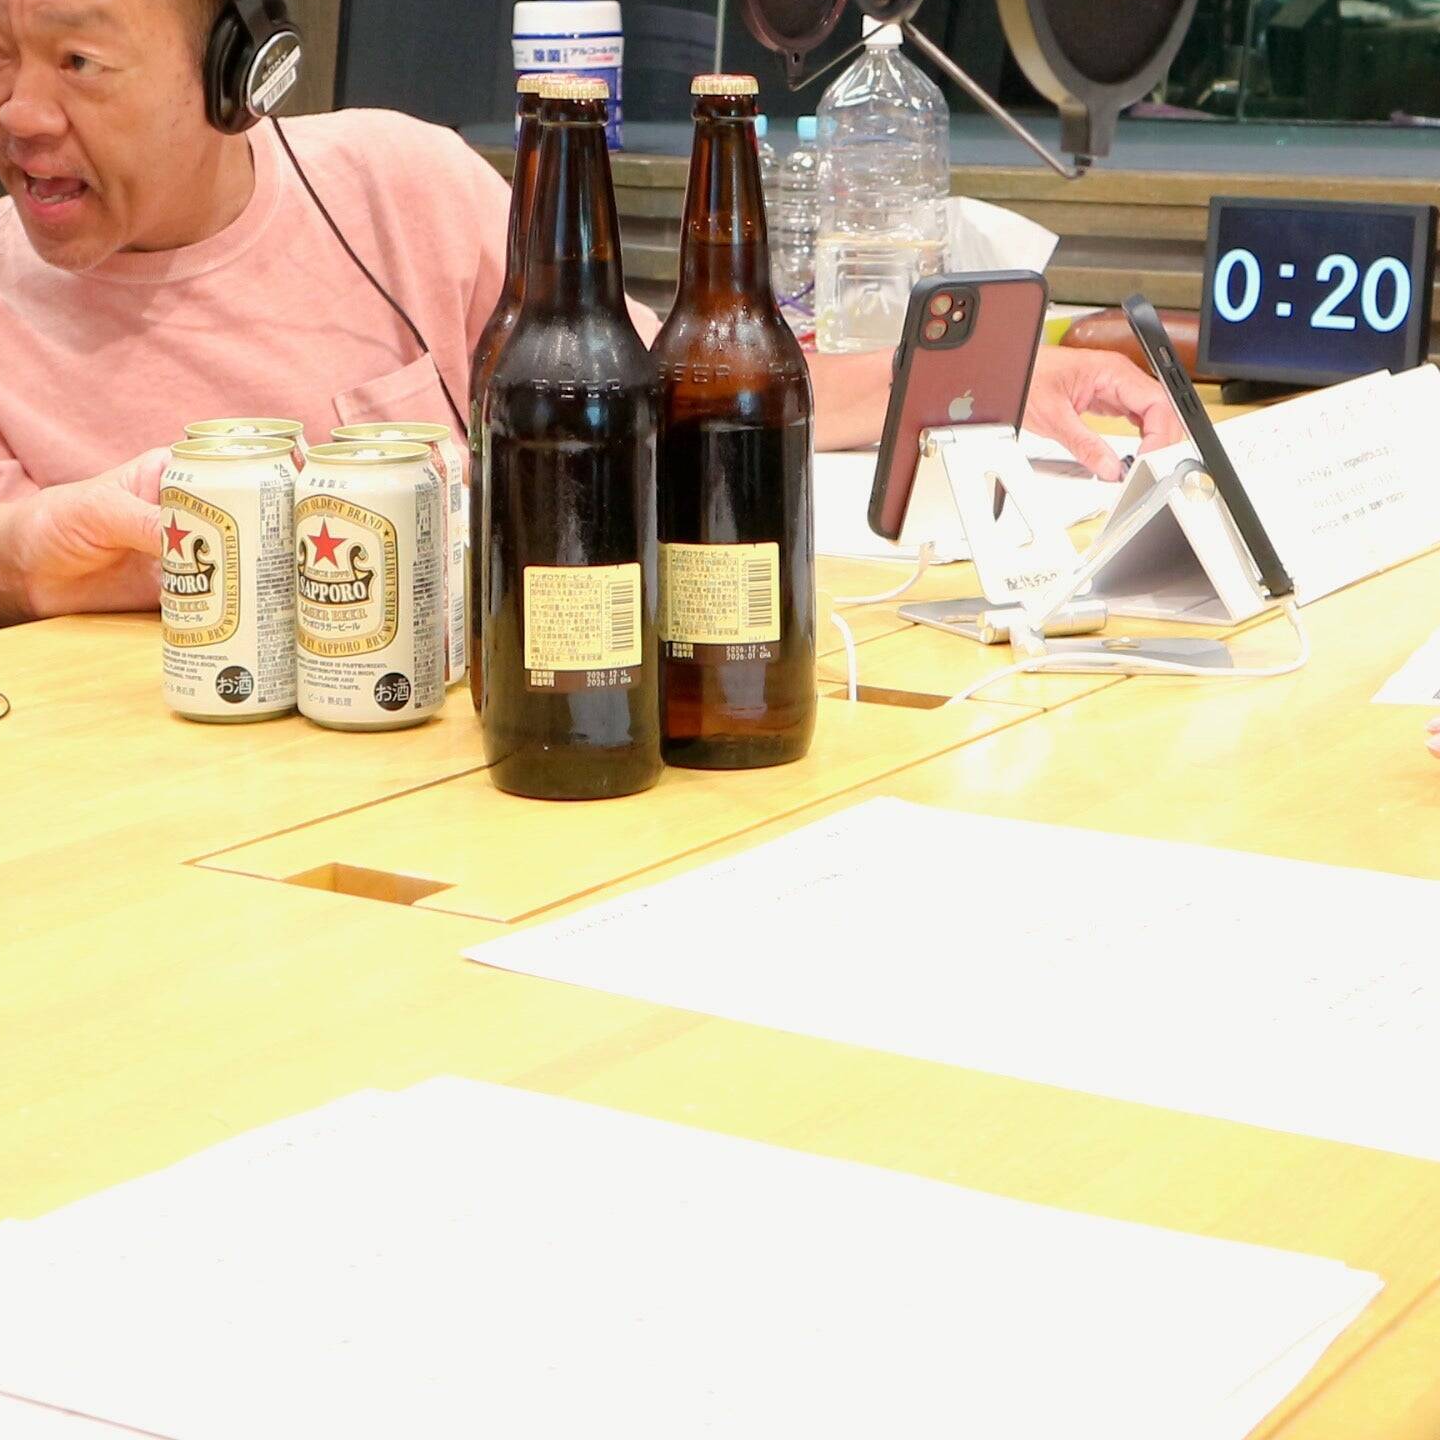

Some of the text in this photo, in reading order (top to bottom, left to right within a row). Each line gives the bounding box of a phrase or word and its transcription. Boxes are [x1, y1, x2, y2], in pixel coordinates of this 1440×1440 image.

[1214, 248, 1410, 332] 0:20
[310, 497, 345, 515] OLDEST
[346, 507, 383, 530] BRAND
[299, 575, 367, 603] SAPPORO
[317, 639, 361, 655] SAPPORO
[366, 590, 396, 649] BREWERIES
[383, 540, 397, 587] LIMITED
[216, 674, 253, 695] お酒
[375, 679, 410, 702] お酒
